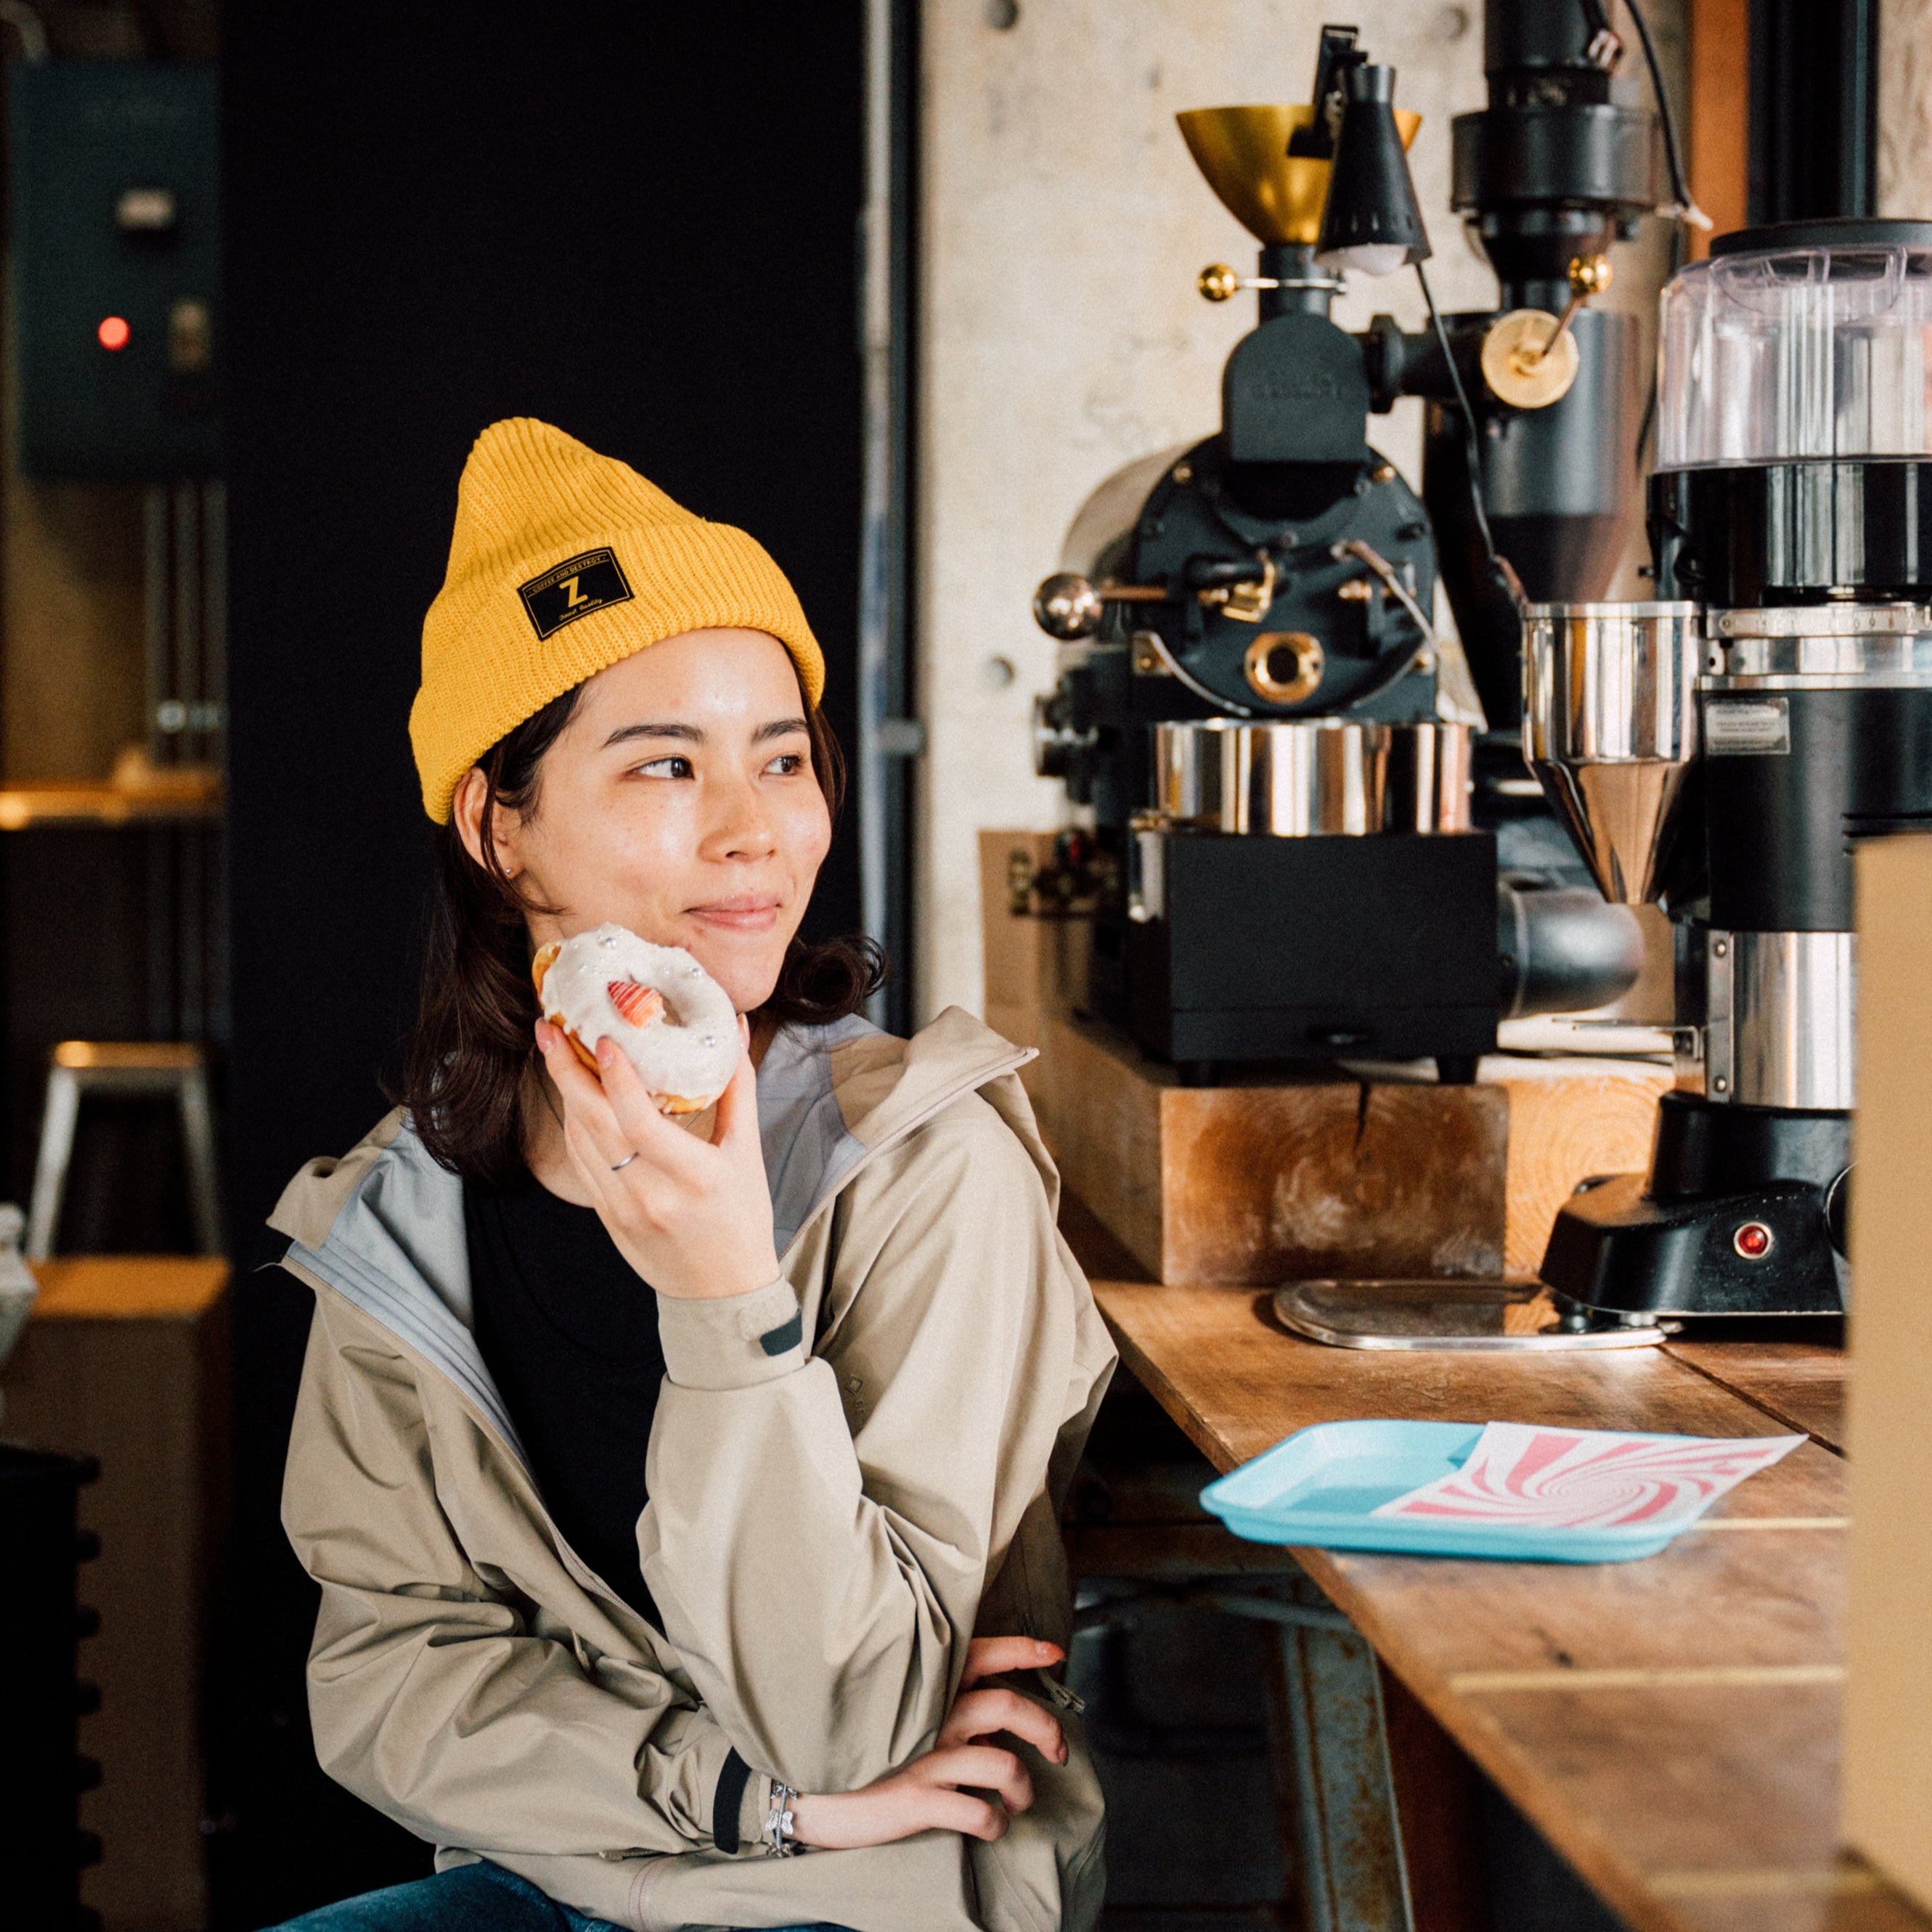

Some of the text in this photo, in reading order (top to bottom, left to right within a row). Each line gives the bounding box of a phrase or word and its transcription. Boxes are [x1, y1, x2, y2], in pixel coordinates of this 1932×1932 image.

[533, 556, 601, 592] COFFEE AND DESTROY
[559, 576, 588, 608] Z
